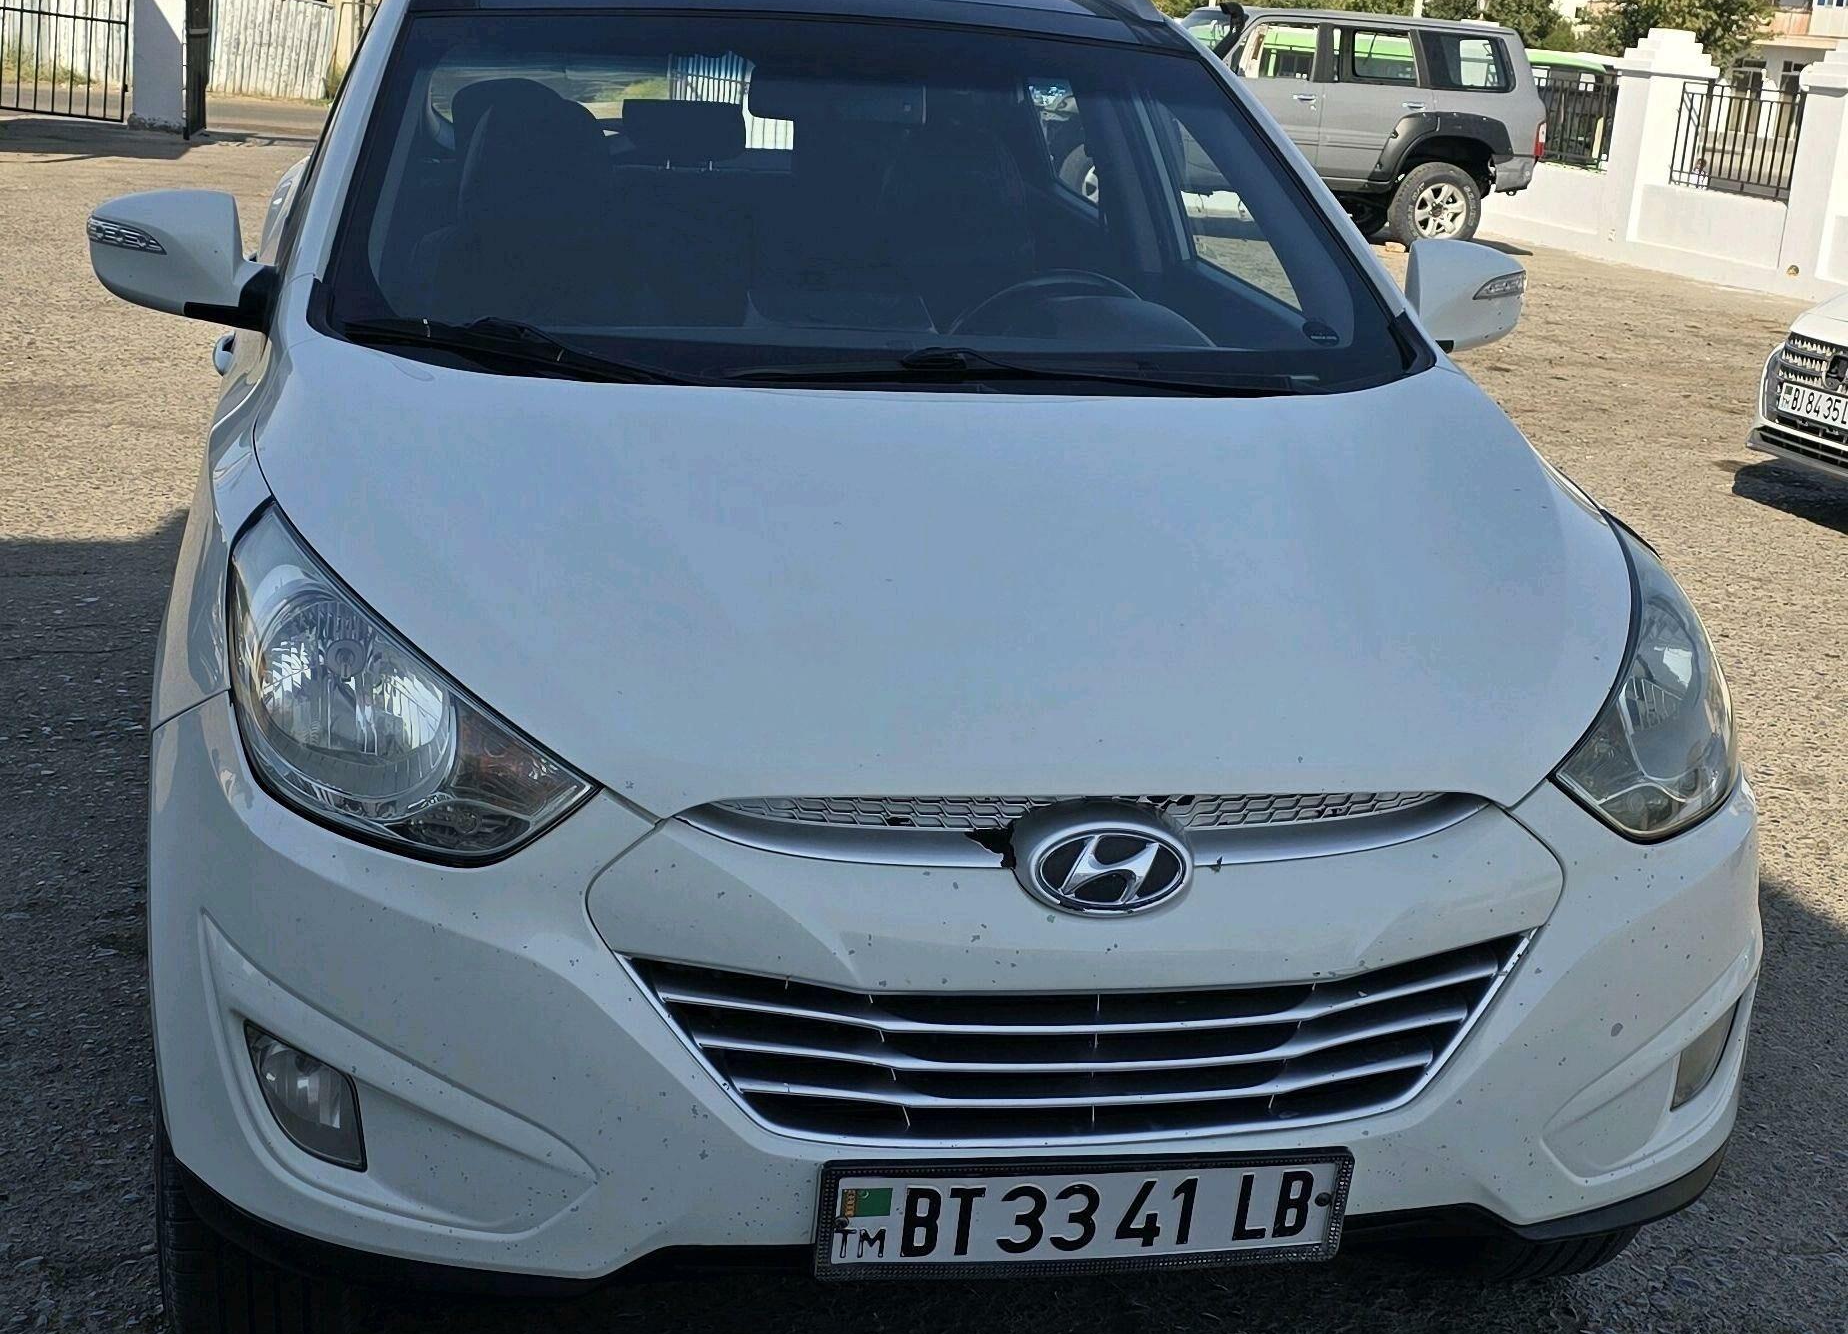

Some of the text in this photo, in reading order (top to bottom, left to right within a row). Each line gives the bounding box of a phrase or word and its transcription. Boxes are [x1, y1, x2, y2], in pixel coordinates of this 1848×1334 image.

[1806, 392, 1822, 416] 84
[1823, 397, 1841, 421] 35
[833, 1227, 886, 1259] TM
[900, 1187, 986, 1257] BT
[1231, 1170, 1315, 1242] LB
